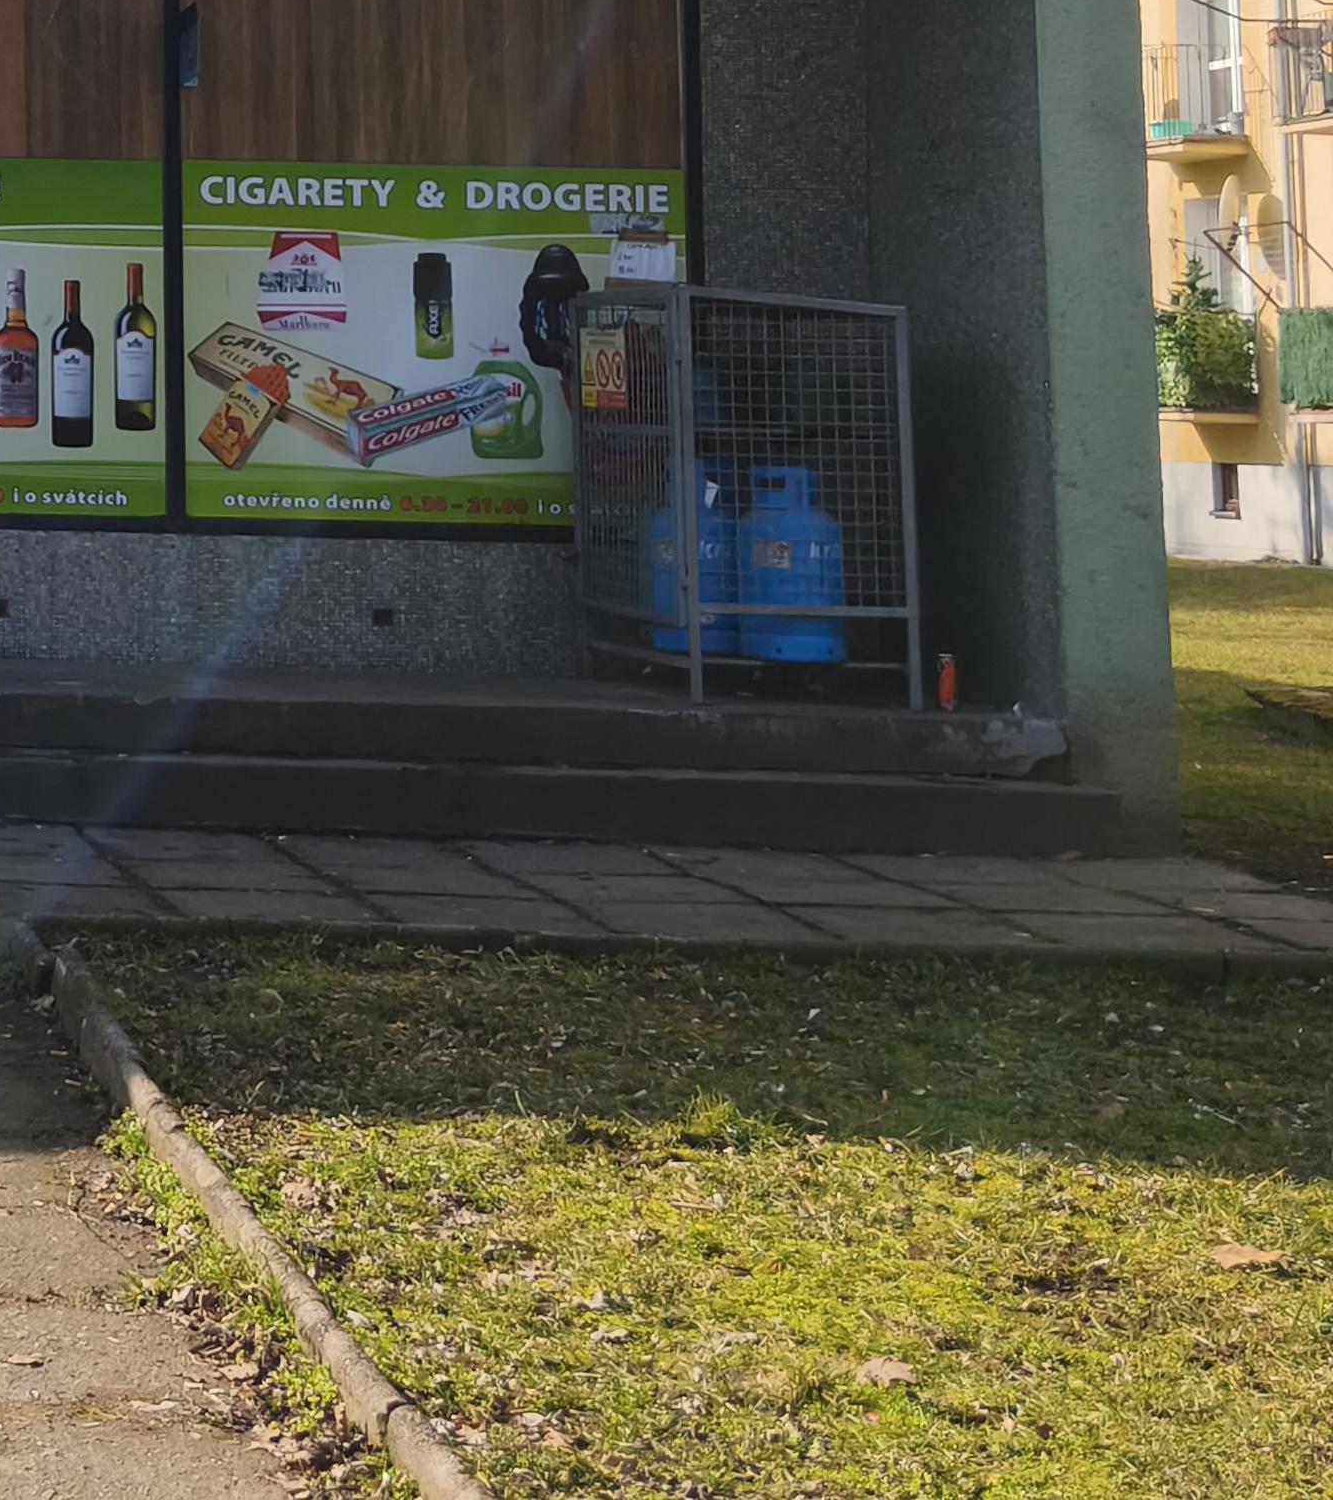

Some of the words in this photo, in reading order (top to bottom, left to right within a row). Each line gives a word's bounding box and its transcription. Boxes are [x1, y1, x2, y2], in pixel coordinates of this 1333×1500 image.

[199, 175, 396, 207] CIGARETY
[416, 180, 445, 209] &
[465, 180, 670, 213] DROGERIE
[217, 334, 302, 379] CAMEL
[228, 390, 260, 419] CAMEL
[506, 381, 521, 397] sil
[357, 389, 448, 423] Colgate
[367, 412, 457, 451] Colgate
[23, 491, 38, 505] o
[41, 487, 129, 506] svátcích
[223, 492, 320, 510] otevřeno
[324, 492, 393, 512] denně
